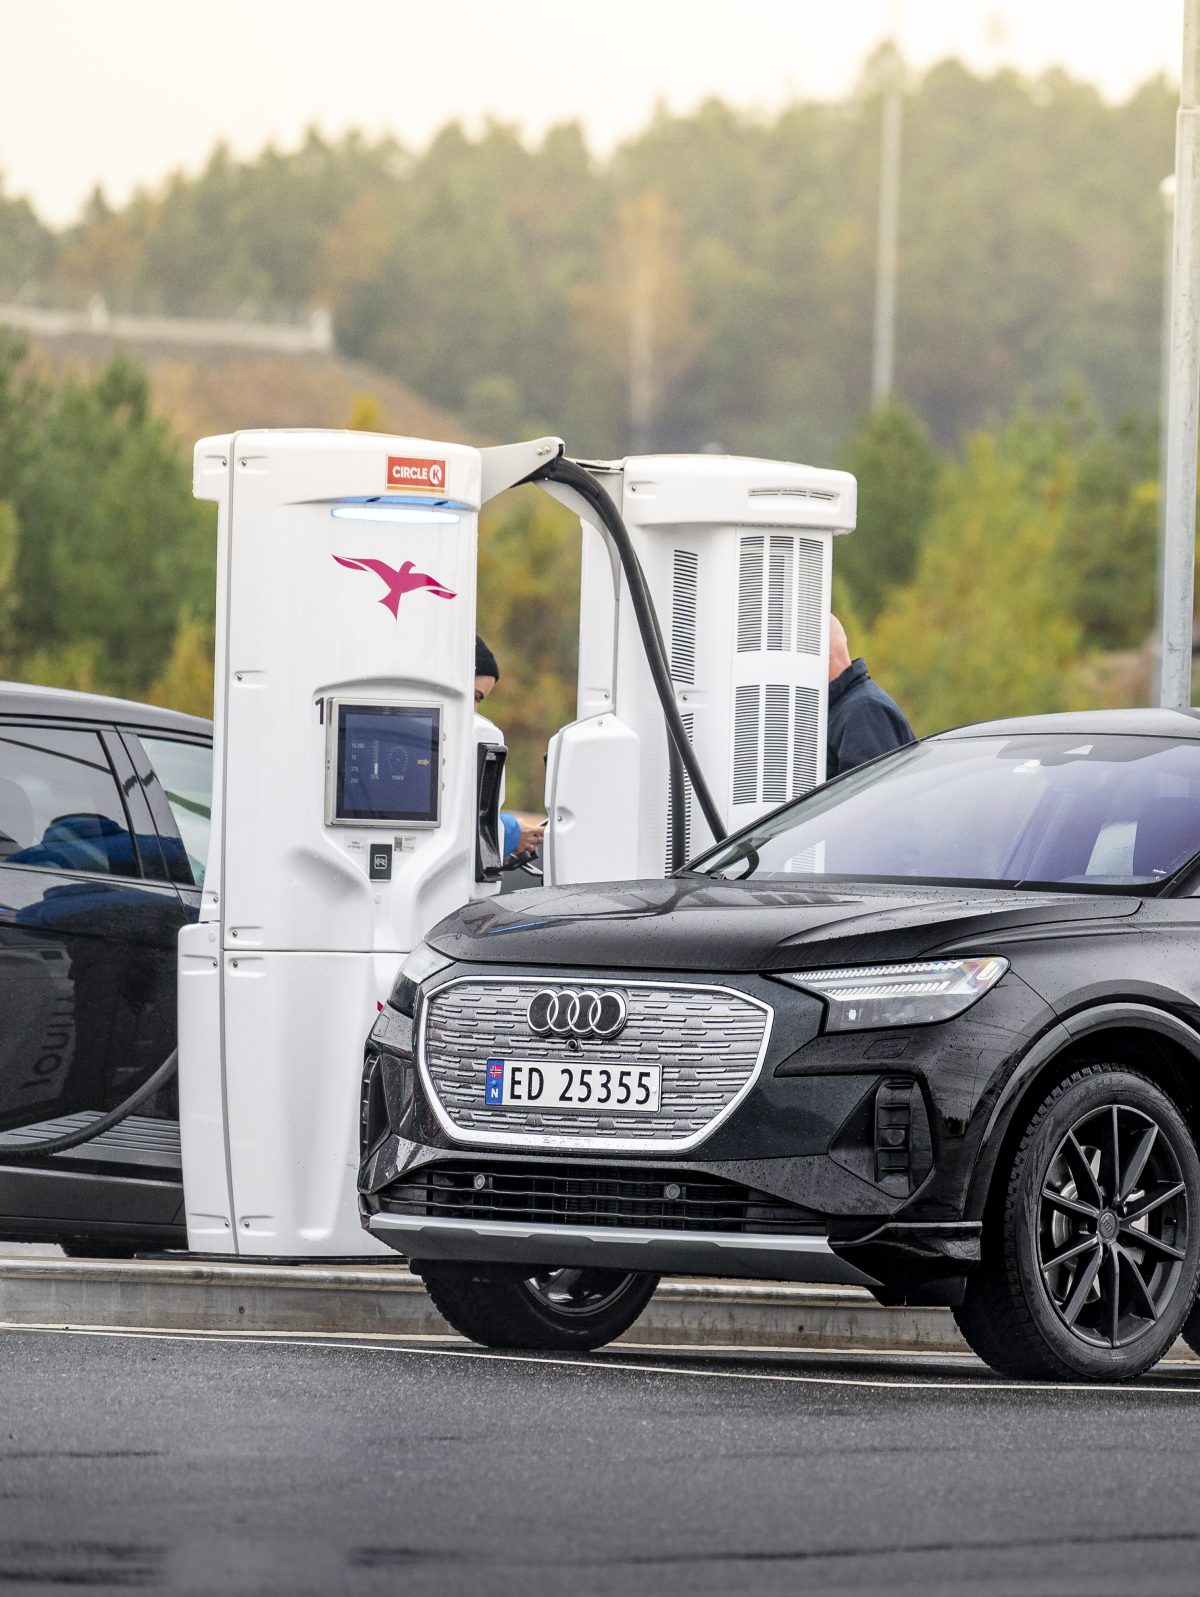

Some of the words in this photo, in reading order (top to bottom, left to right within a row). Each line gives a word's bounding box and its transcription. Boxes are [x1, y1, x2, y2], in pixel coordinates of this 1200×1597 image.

[392, 465, 428, 480] CIRCLE
[430, 464, 442, 485] K
[315, 697, 324, 725] 1
[490, 1087, 499, 1099] N
[510, 1066, 544, 1101] ED
[558, 1068, 651, 1105] 25355
